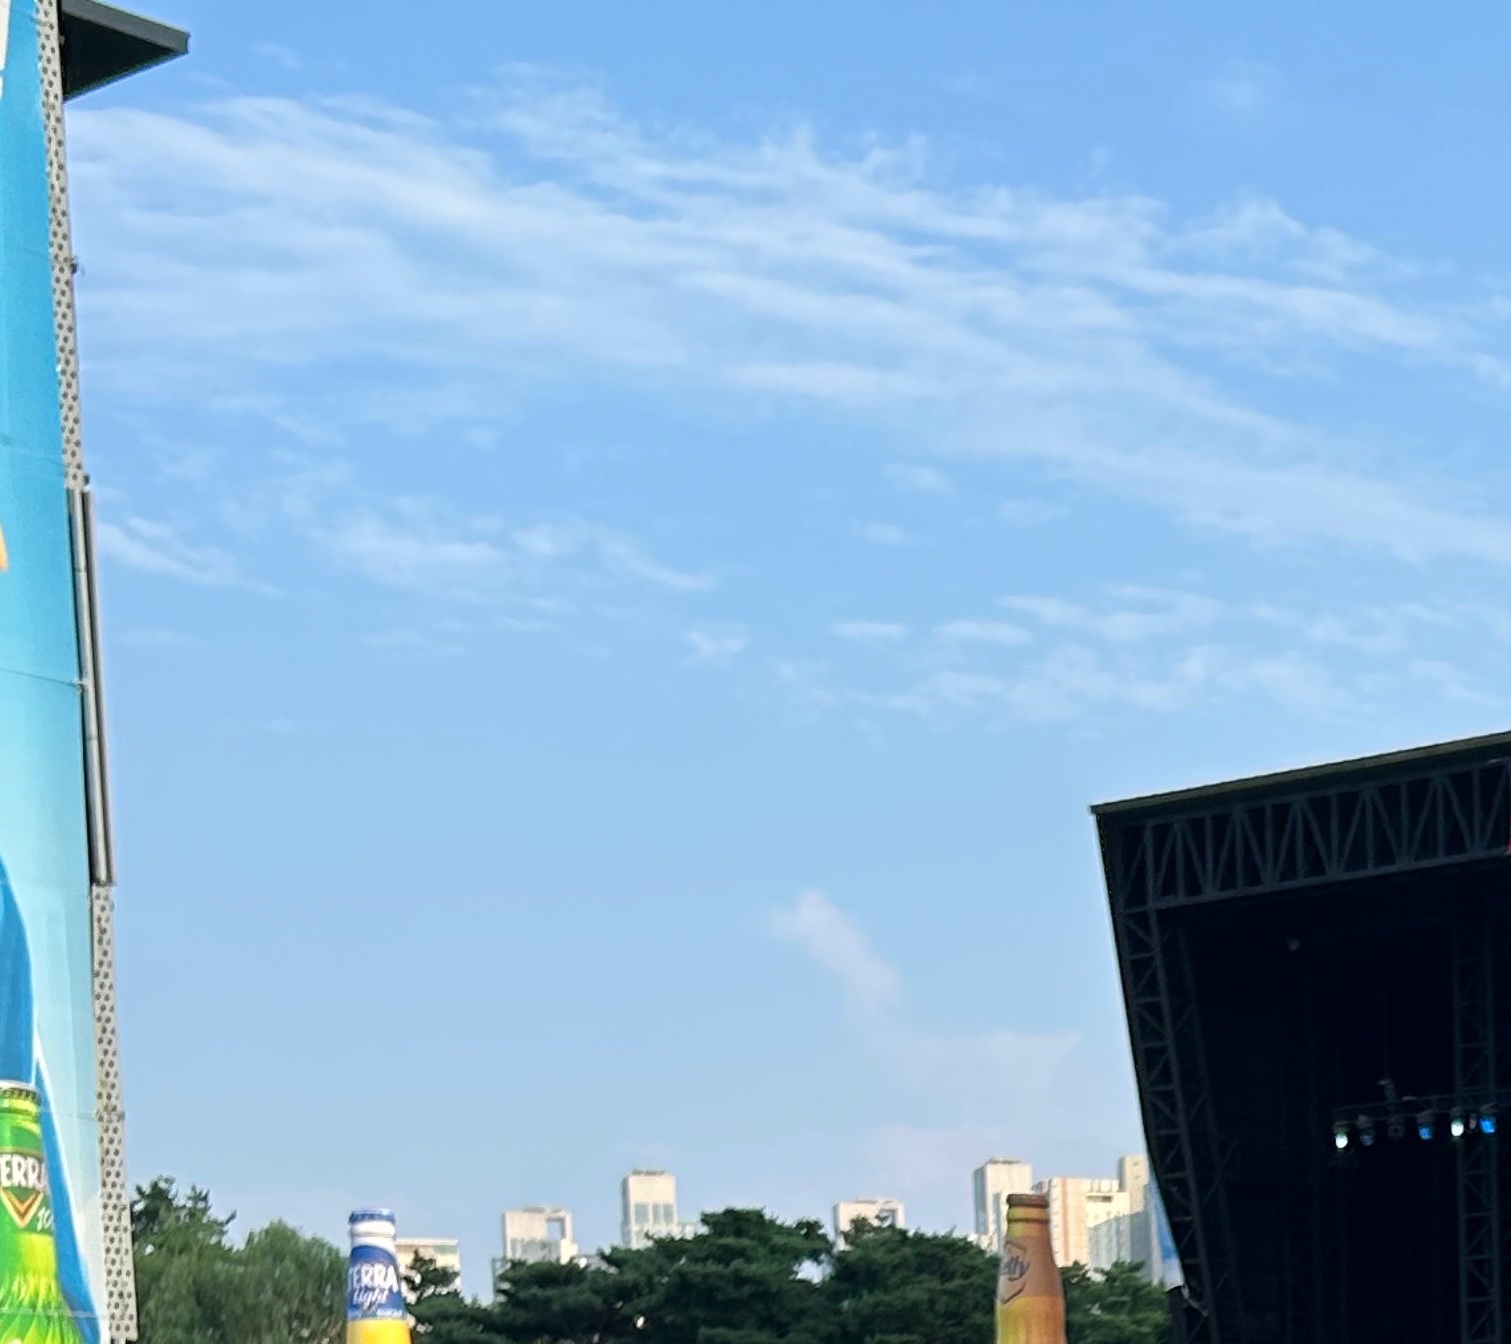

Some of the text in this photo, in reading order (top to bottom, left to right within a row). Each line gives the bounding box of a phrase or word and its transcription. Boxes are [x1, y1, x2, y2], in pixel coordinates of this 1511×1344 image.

[0, 1153, 48, 1191] ERRA
[347, 1262, 399, 1295] TERRA
[1002, 1253, 1030, 1282] elly
